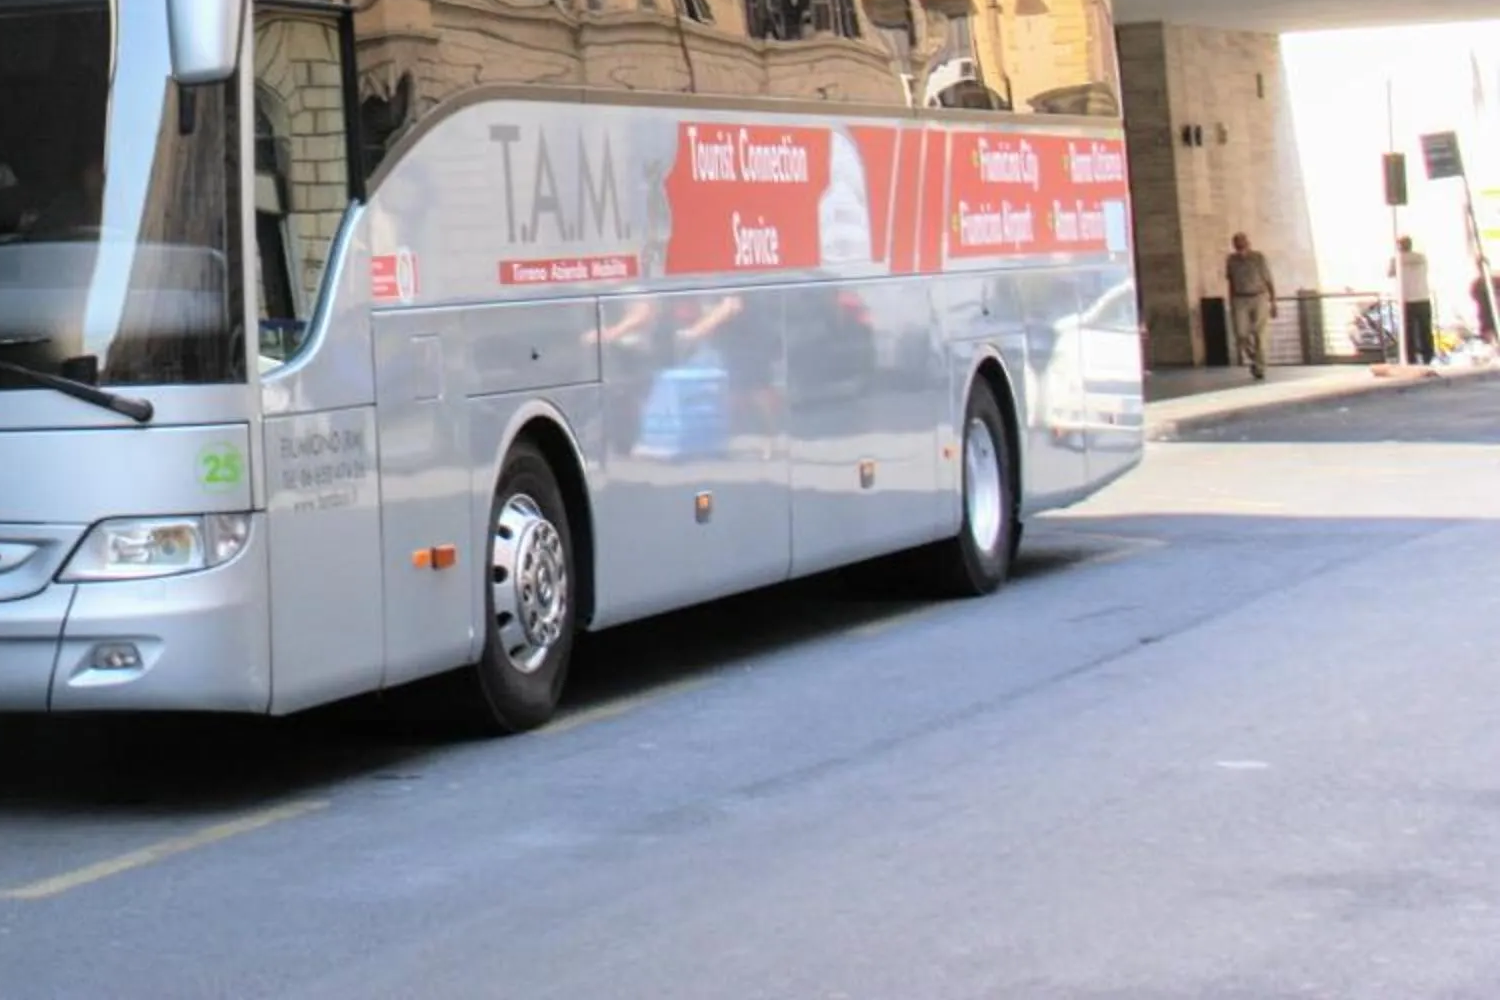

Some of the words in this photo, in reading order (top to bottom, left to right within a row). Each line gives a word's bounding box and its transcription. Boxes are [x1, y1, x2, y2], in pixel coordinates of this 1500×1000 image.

[687, 125, 737, 182] Tourist
[738, 127, 810, 183] Connection
[489, 123, 631, 244] T.A.M.
[731, 210, 780, 267] Service
[203, 453, 242, 483] 25
